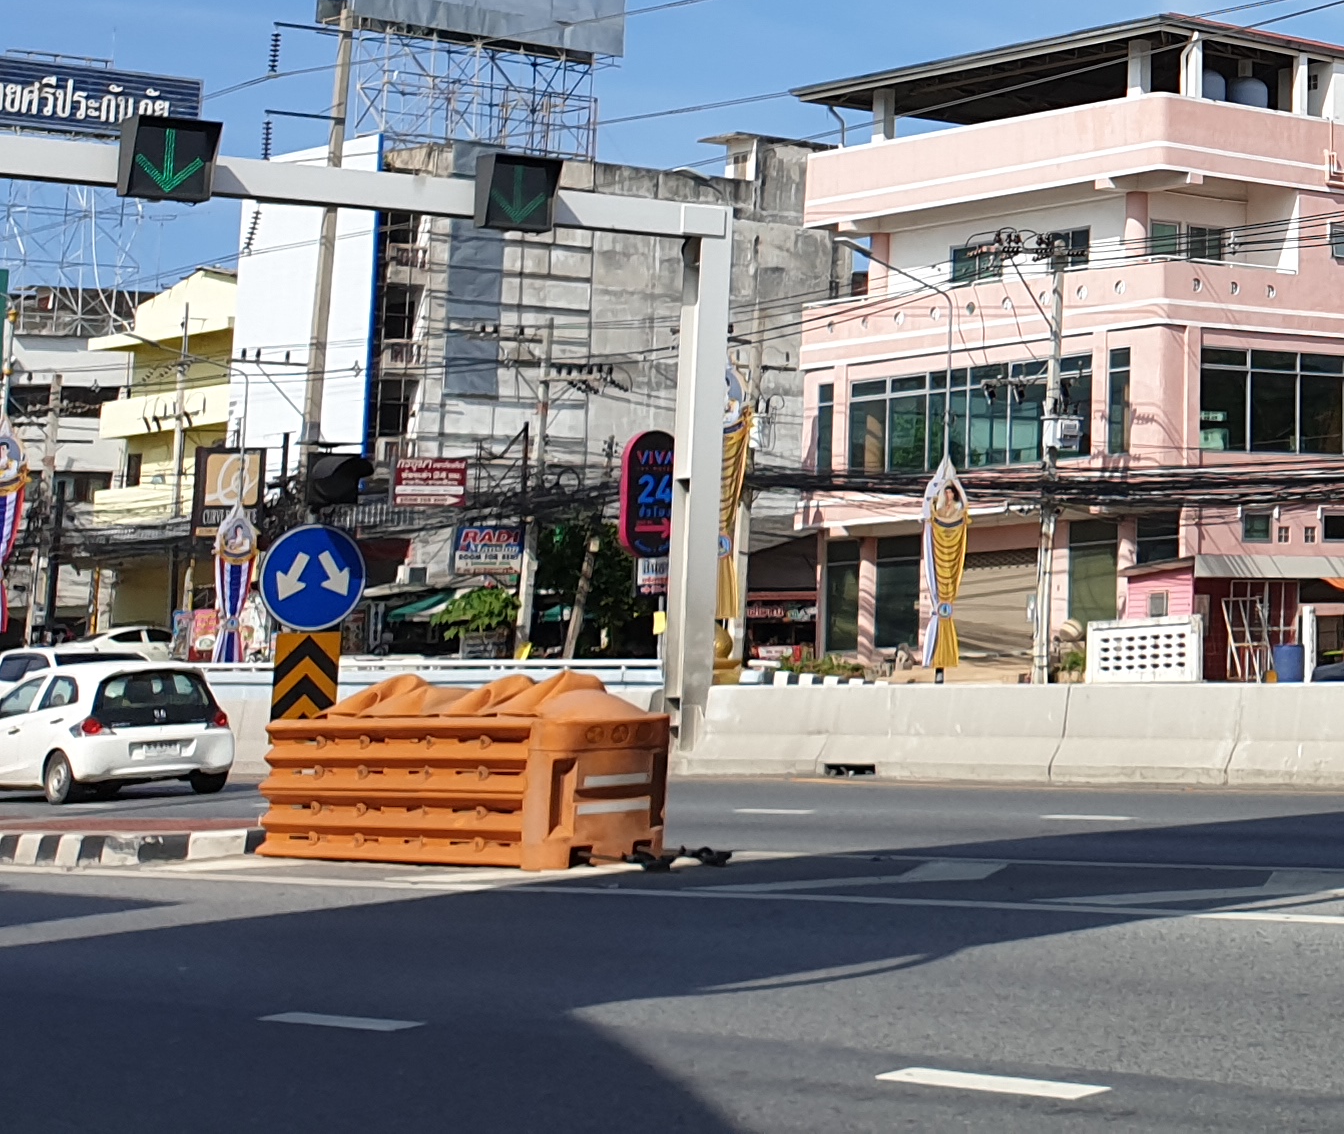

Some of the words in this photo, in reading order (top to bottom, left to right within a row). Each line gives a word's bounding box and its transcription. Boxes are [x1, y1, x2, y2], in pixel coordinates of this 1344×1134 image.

[0, 75, 171, 123] ยศรีประกันภัย
